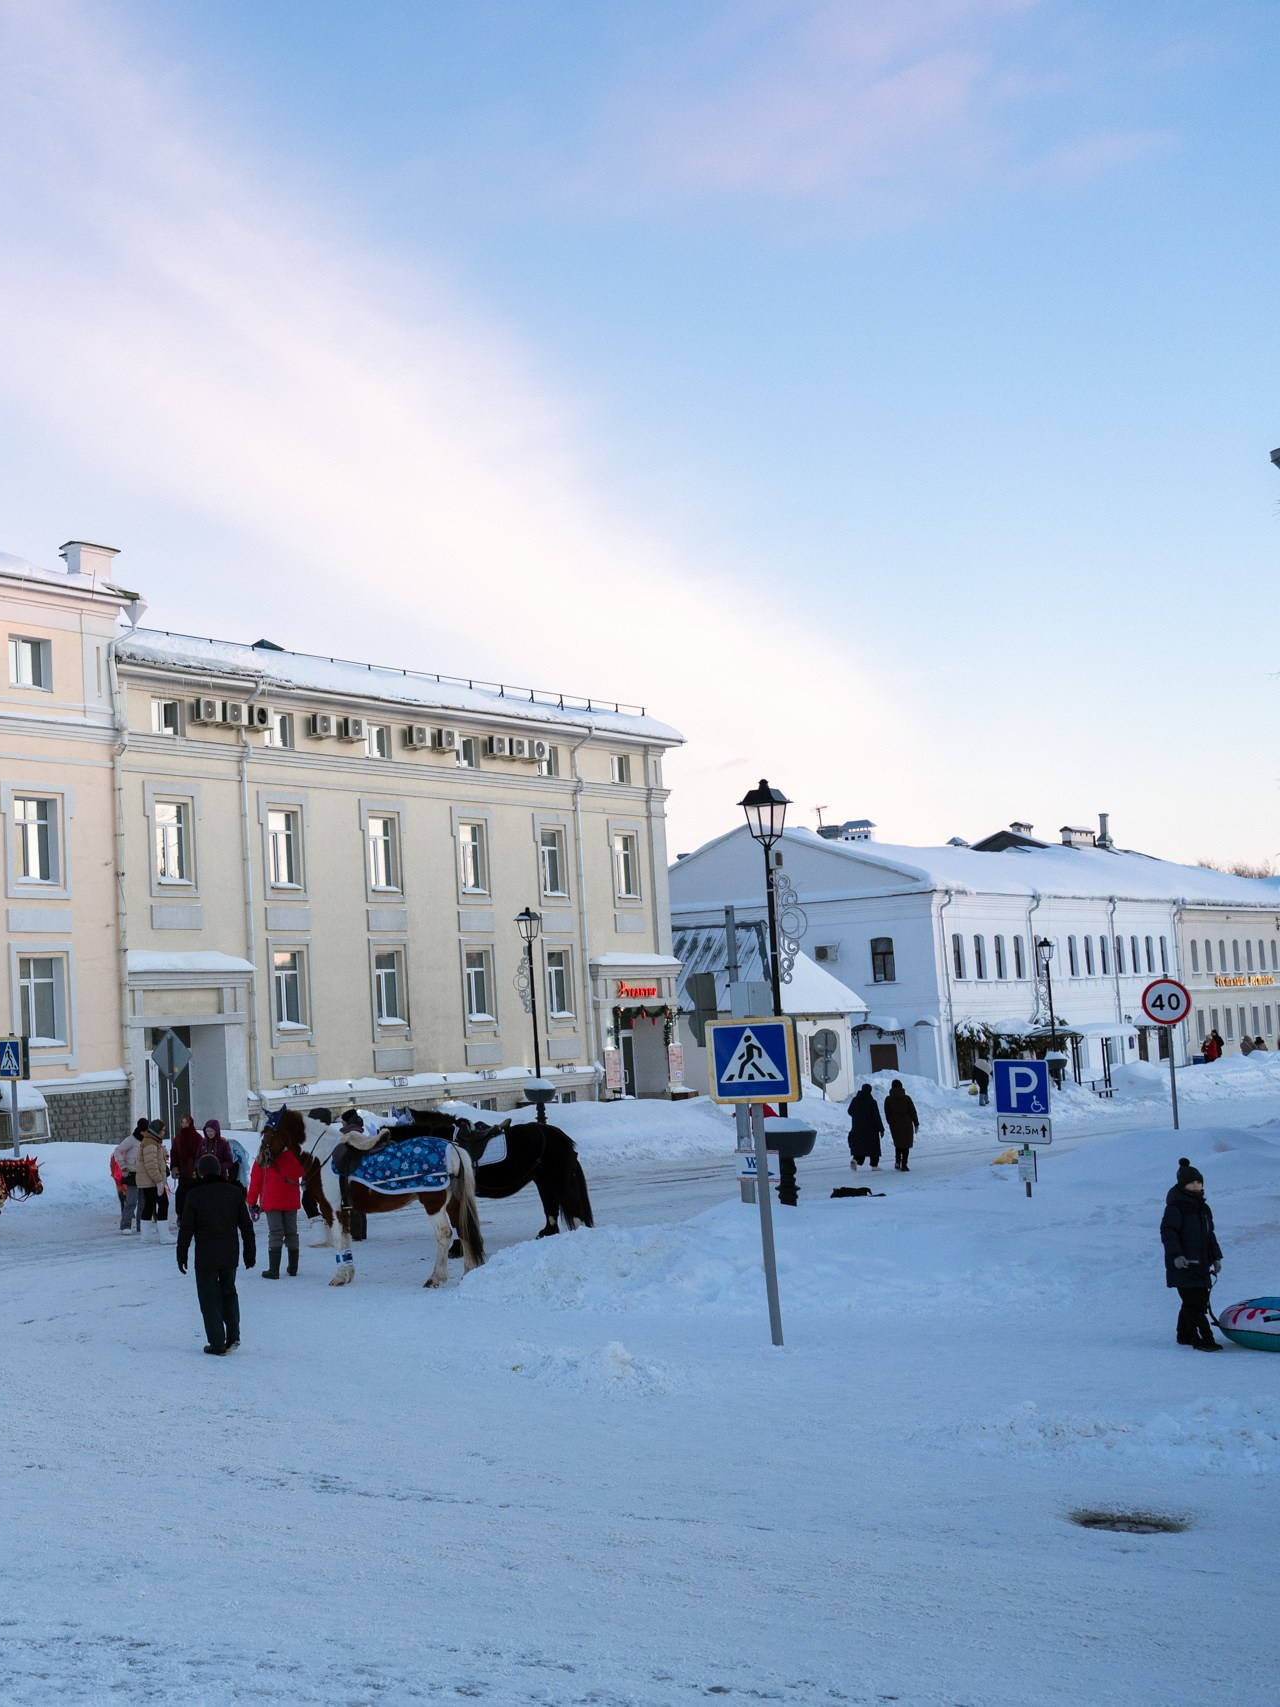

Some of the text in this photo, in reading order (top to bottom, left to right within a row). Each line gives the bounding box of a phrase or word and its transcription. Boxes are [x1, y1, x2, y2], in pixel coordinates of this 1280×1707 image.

[626, 987, 657, 997] ТРАКТИР
[1151, 993, 1180, 1011] 40
[1008, 1066, 1038, 1108] P
[1009, 1124, 1039, 1136] 22,5м
